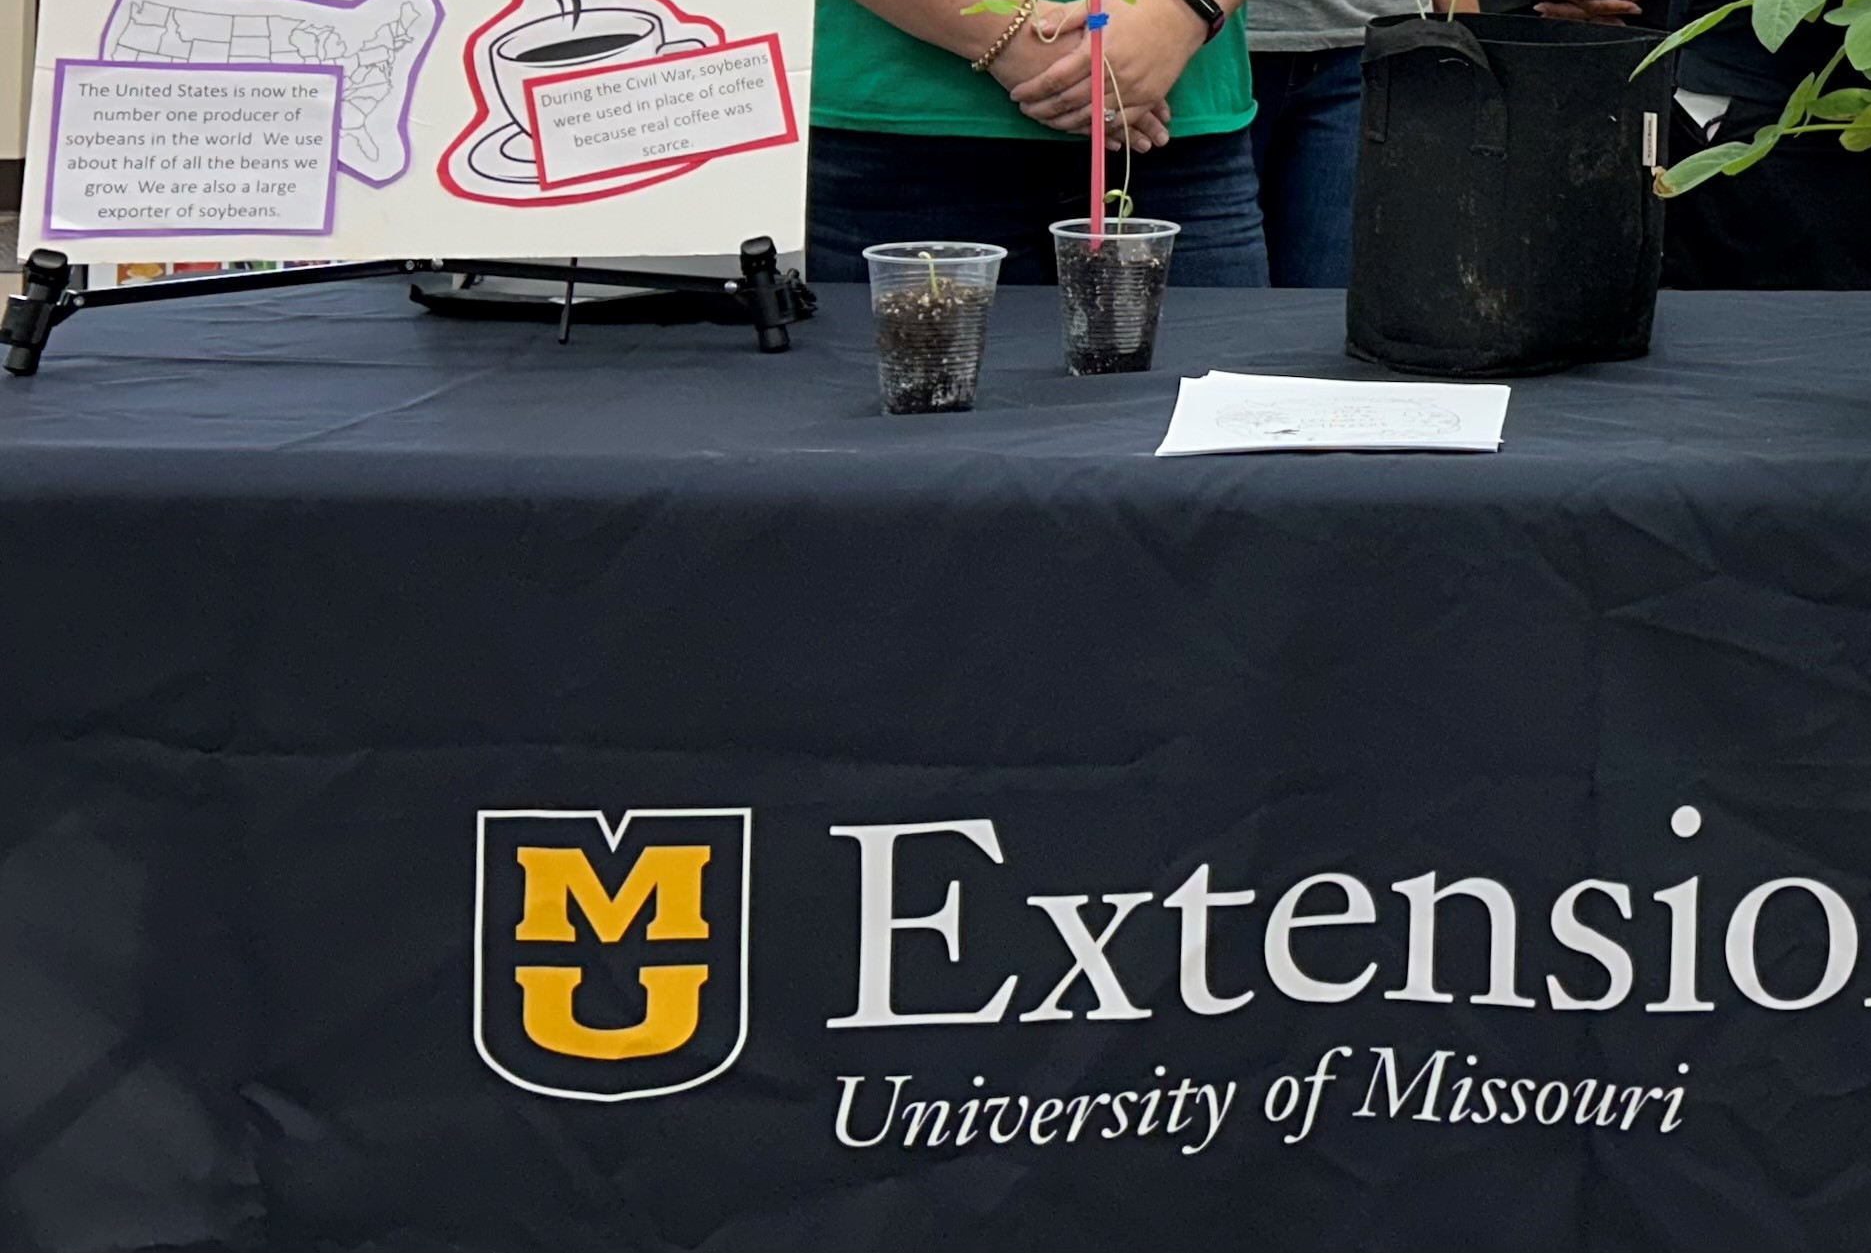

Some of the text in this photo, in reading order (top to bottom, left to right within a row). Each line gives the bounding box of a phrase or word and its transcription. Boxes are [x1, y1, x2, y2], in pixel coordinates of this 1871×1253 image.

[78, 83, 318, 97] The United States is now the
[93, 107, 301, 124] number one producer of
[67, 155, 317, 169] about half of all the beans we
[833, 1045, 1690, 1154] University of Missouri
